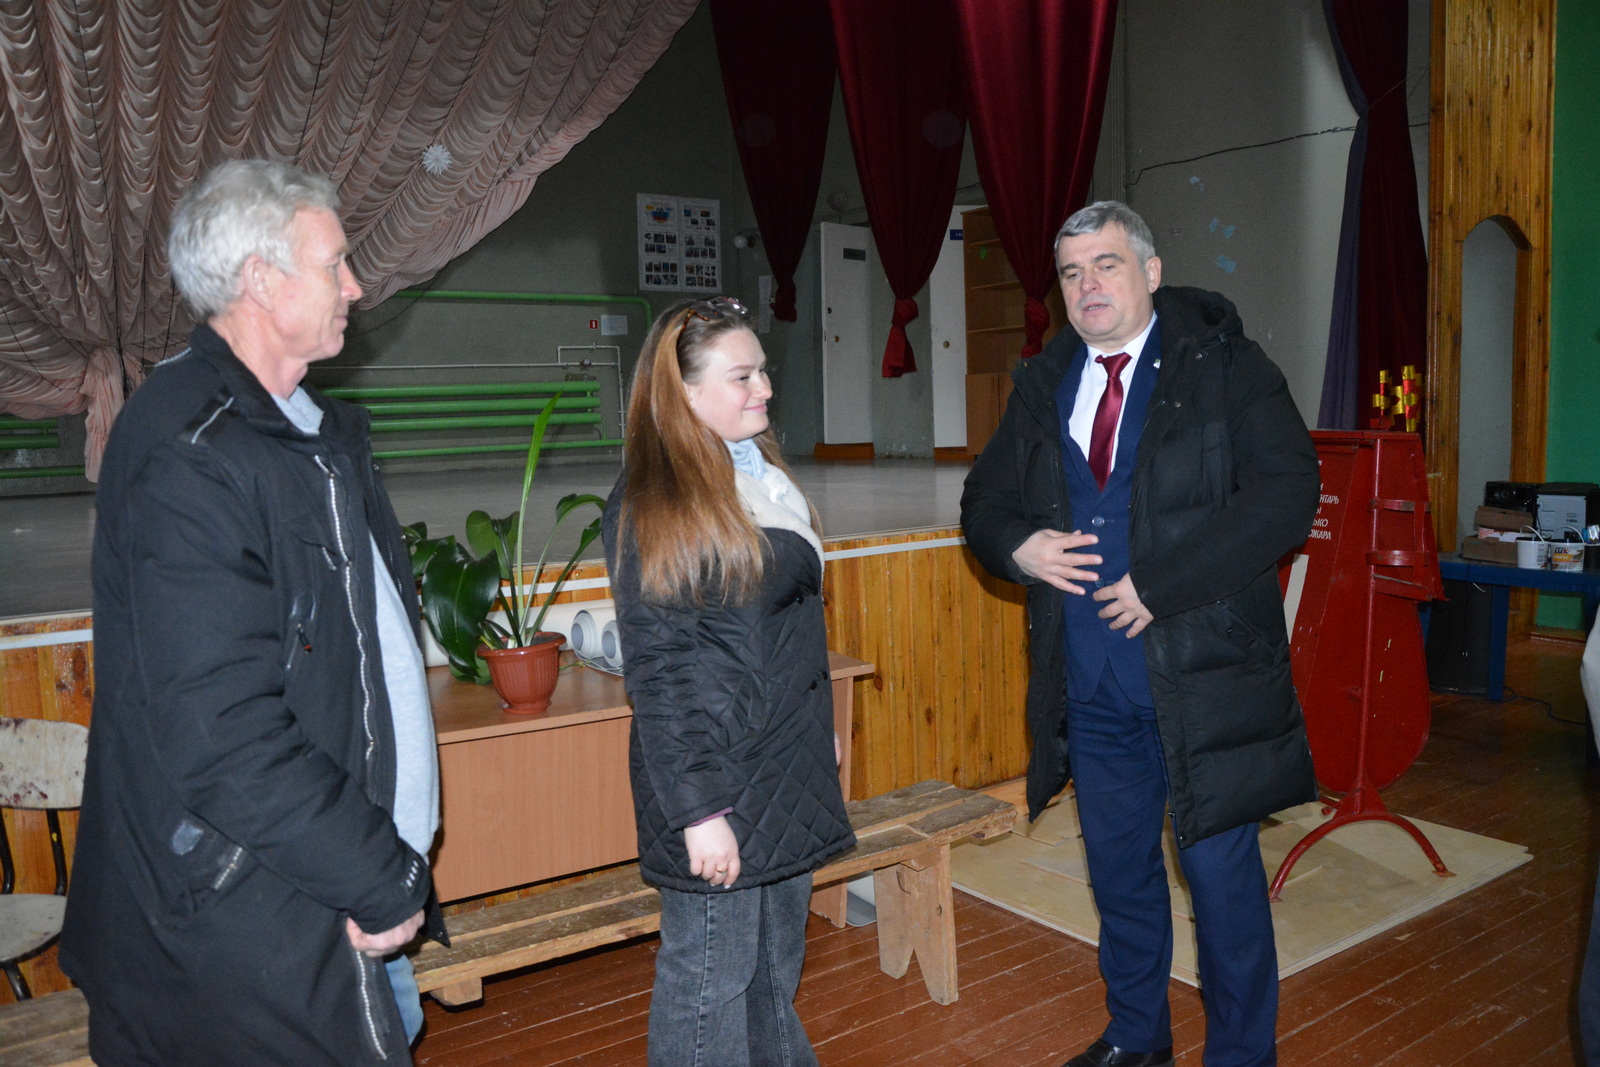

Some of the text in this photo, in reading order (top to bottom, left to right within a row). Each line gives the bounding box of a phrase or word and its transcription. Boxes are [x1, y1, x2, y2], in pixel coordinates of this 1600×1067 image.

[1319, 494, 1340, 504] НТАРЬ
[1312, 518, 1329, 527] ЬКО
[1308, 529, 1331, 540] ОЖАРА
